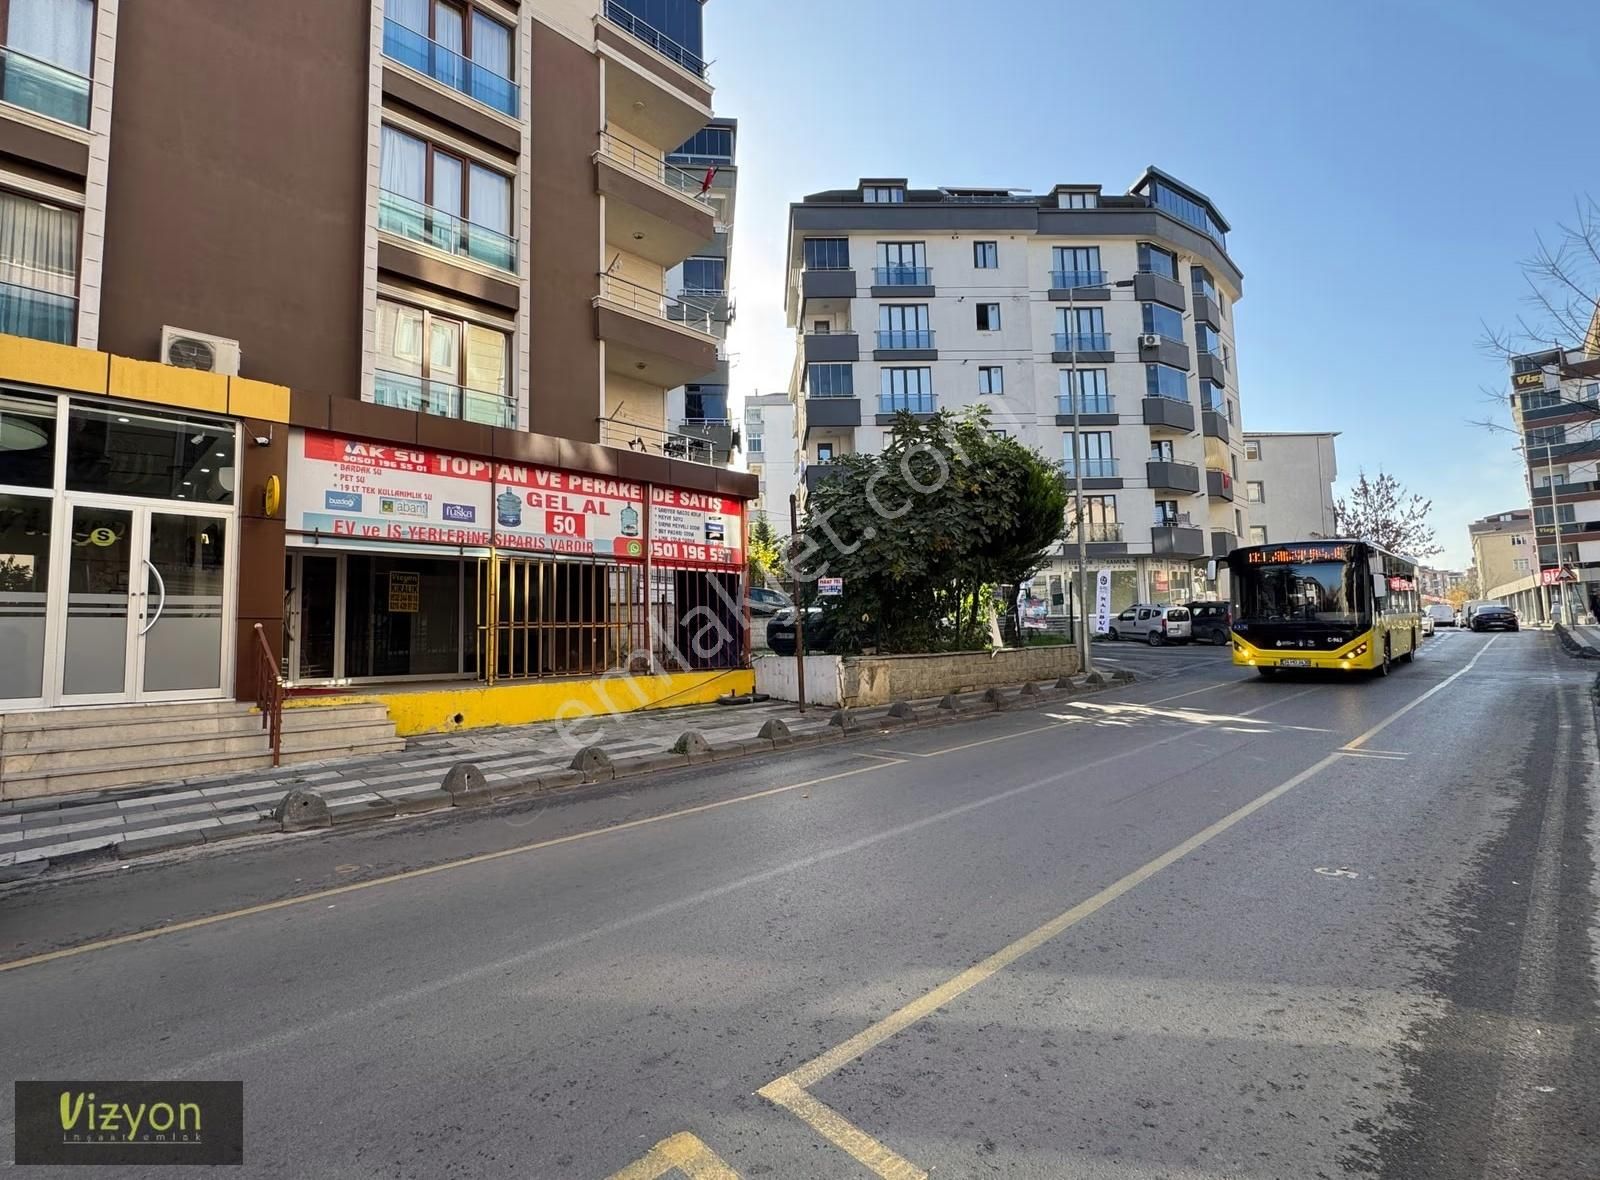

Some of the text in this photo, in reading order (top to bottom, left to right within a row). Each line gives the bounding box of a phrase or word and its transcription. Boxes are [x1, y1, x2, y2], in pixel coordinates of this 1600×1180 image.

[351, 444, 425, 464] AK SU
[340, 463, 382, 476] BARDAK SU
[350, 456, 376, 465] 0501
[378, 459, 397, 469] 196
[416, 465, 427, 473] 01
[436, 454, 528, 484] TOPTAN
[536, 471, 561, 486] VE
[340, 473, 365, 484] PET SU
[340, 483, 433, 501] 19 LT TEK KULLANIMLIK SU
[526, 492, 611, 516] GEL AL
[334, 520, 355, 536] EV
[363, 525, 380, 537] ve
[553, 516, 576, 534] 50
[682, 544, 706, 560] 196
